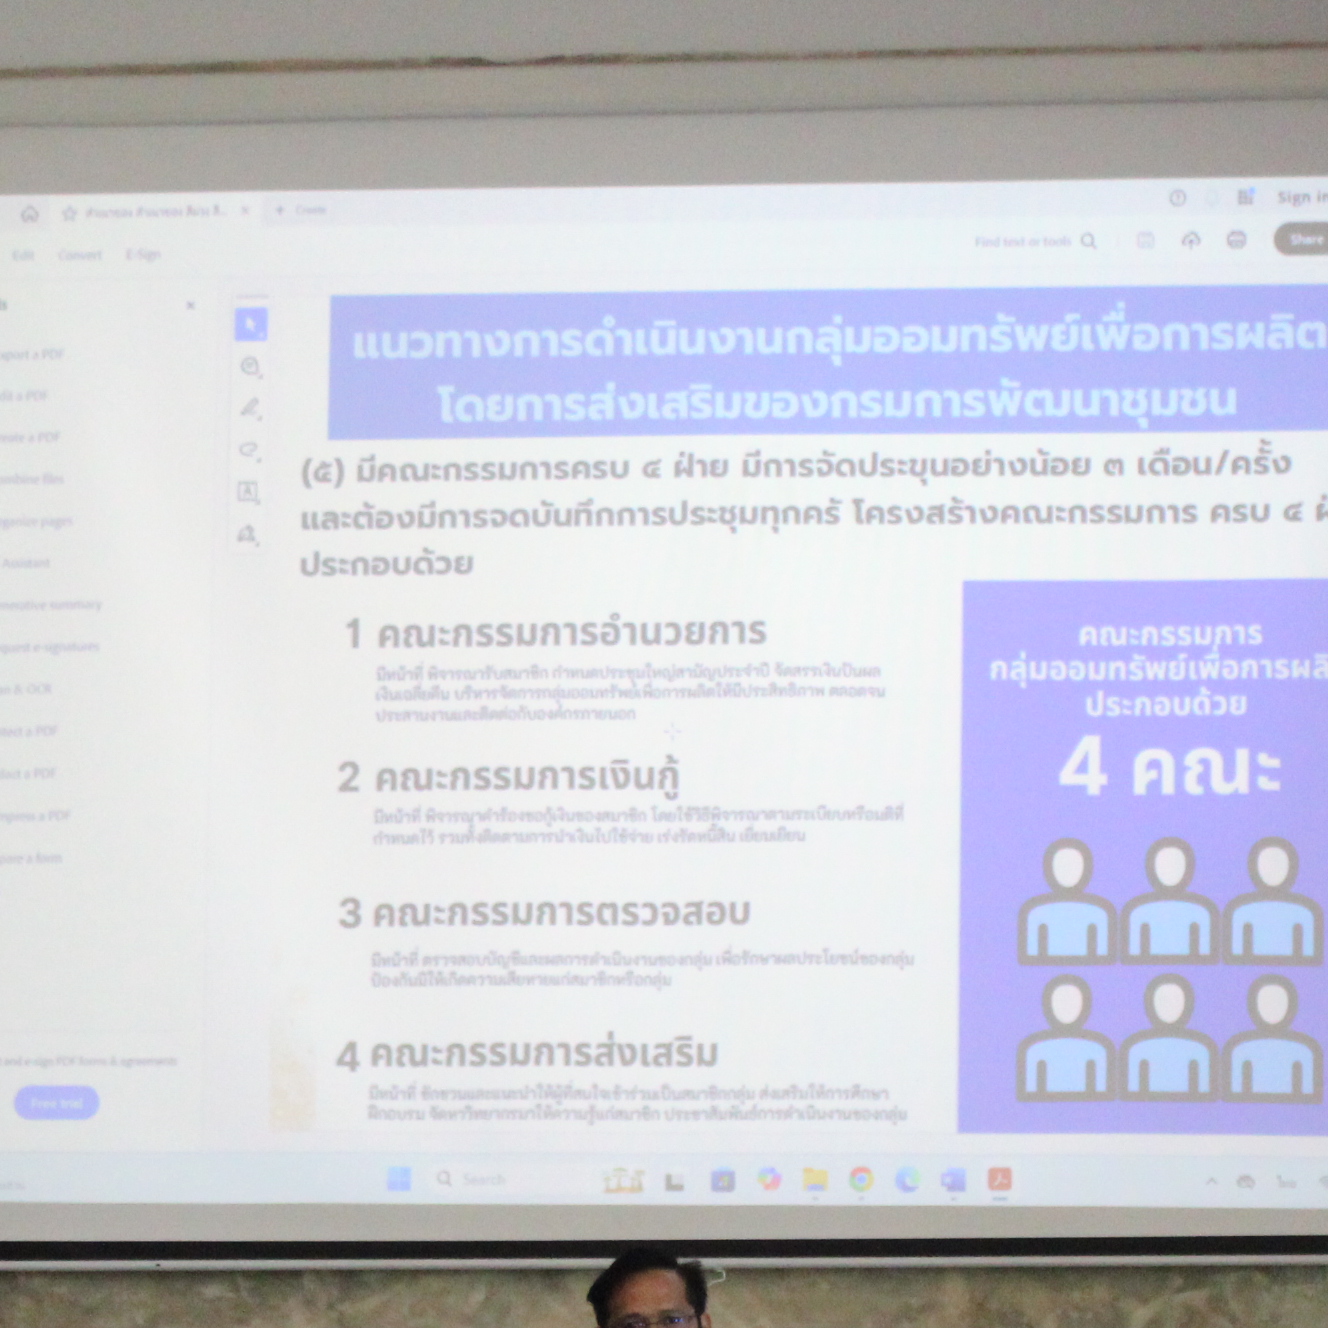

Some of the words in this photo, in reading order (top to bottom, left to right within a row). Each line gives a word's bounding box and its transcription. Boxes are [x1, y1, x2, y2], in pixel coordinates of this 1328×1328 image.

[1278, 190, 1312, 206] Sign
[975, 235, 999, 248] Find
[1043, 235, 1072, 248] tools
[1289, 232, 1325, 247] Share
[11, 248, 35, 262] Edit
[58, 247, 103, 261] Convert
[353, 301, 1328, 367] แนวทางการดำเนินงานกลุ่มออมทรัพย์เพื่อการผลิต
[41, 348, 65, 360] PDF
[25, 389, 48, 401] PDF
[437, 377, 1238, 430] โดยการส่งเสริมของกรมการพัฒนาชุมชน
[37, 430, 61, 442] PDF
[302, 457, 345, 489] (๕)
[356, 453, 630, 483] มีคณะกรรมการครบ
[642, 458, 663, 480] ๔
[673, 452, 729, 478] ฝ่าย
[1104, 457, 1124, 476] ๓
[1137, 438, 1292, 477] เดือน/ครั้ง
[42, 472, 65, 485] files
[853, 496, 1198, 527] โครงสร้างคณะกรรมการ
[1210, 501, 1270, 524] ครบ
[1283, 501, 1305, 522] ๔
[2, 557, 50, 569] Assistant
[300, 546, 474, 578] ประกอบด้วย
[346, 617, 361, 649] 1
[378, 612, 768, 648] คณะกรรมการอำนวยการ
[1078, 623, 1263, 647] คณะกรรมการ
[1085, 686, 1249, 718] ประกอบด้วย
[35, 725, 58, 737] PDF
[34, 767, 57, 779] PDF
[1058, 735, 1108, 796] 4
[1133, 746, 1281, 796] คณะ
[338, 761, 360, 793] 2
[375, 754, 680, 800] คณะกรรมการเงินกู้
[48, 809, 71, 821] PDF
[339, 897, 362, 929] 3
[373, 899, 752, 928] คณะกรรมการตรวจสอบ
[335, 1041, 360, 1072] 4
[370, 1030, 719, 1068] คณะกรรมการส่งเสริม
[30, 1098, 57, 1110] Free
[60, 1097, 83, 1110] trial
